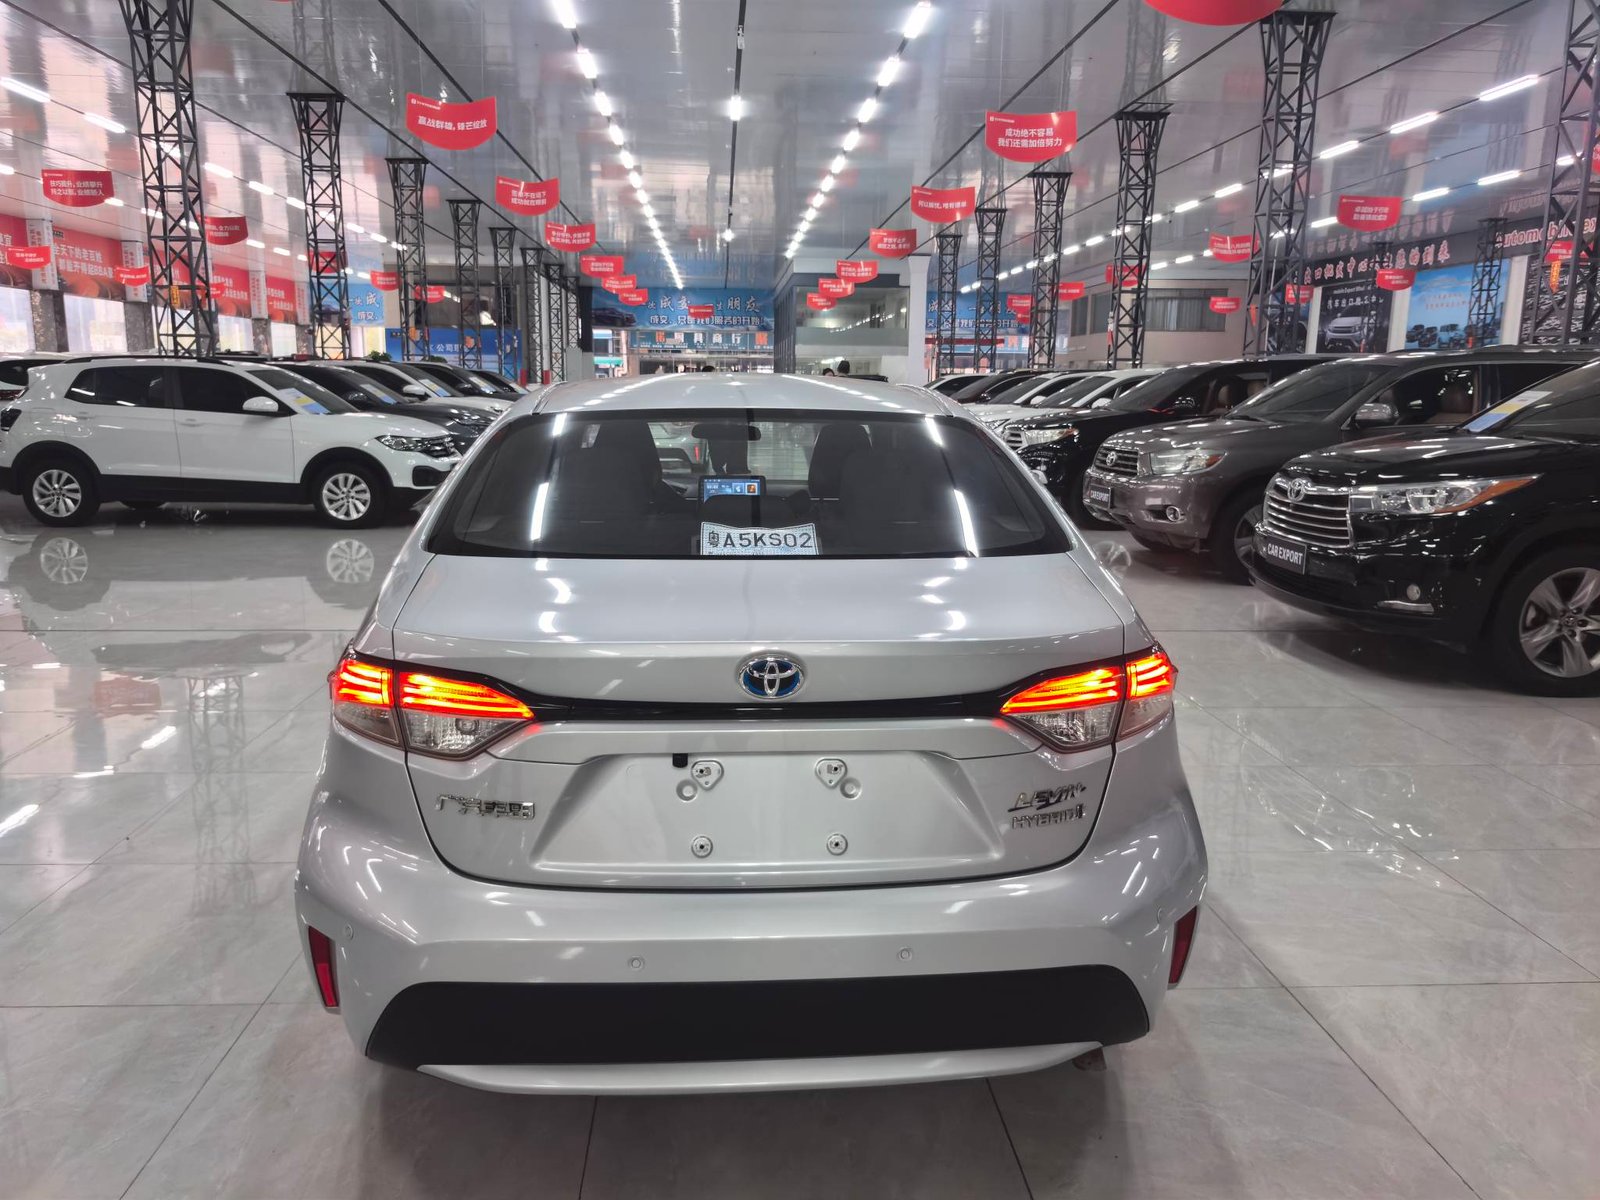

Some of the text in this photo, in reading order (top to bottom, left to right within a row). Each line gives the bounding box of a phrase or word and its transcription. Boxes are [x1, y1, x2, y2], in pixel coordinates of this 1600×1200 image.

[1005, 127, 1053, 138] 成功绝不容易
[998, 137, 1062, 149] 我们还需加倍努力
[1267, 543, 1303, 565] CAR EXPORT
